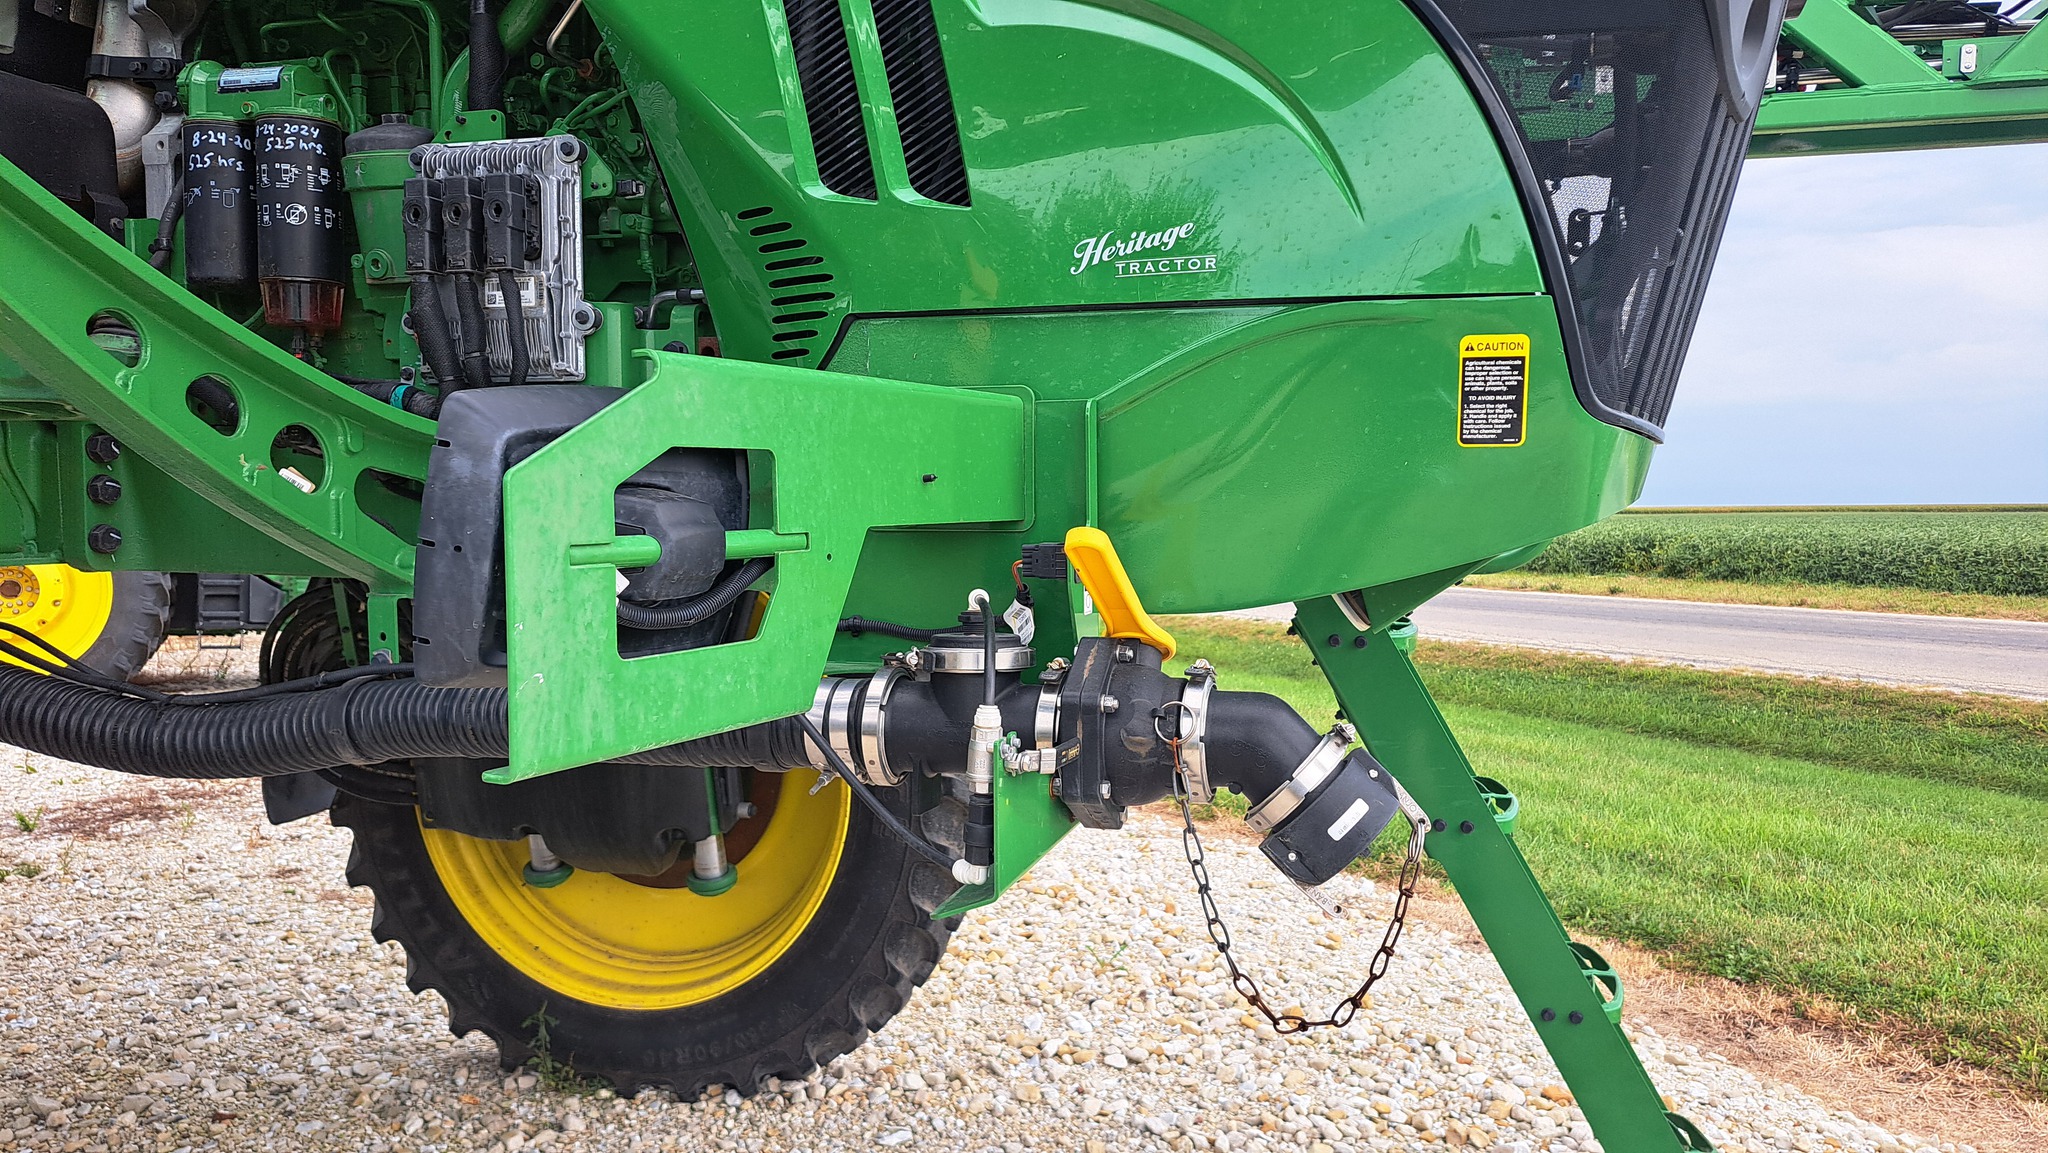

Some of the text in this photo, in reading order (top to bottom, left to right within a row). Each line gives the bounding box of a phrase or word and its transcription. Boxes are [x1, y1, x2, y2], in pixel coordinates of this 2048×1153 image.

[192, 131, 253, 151] 8-24-20
[265, 137, 327, 156] 525 hrs.
[188, 152, 214, 171] 525
[1070, 222, 1196, 275] Heritage
[1115, 257, 1217, 275] TRACTOR
[1477, 342, 1524, 351] CAUTION
